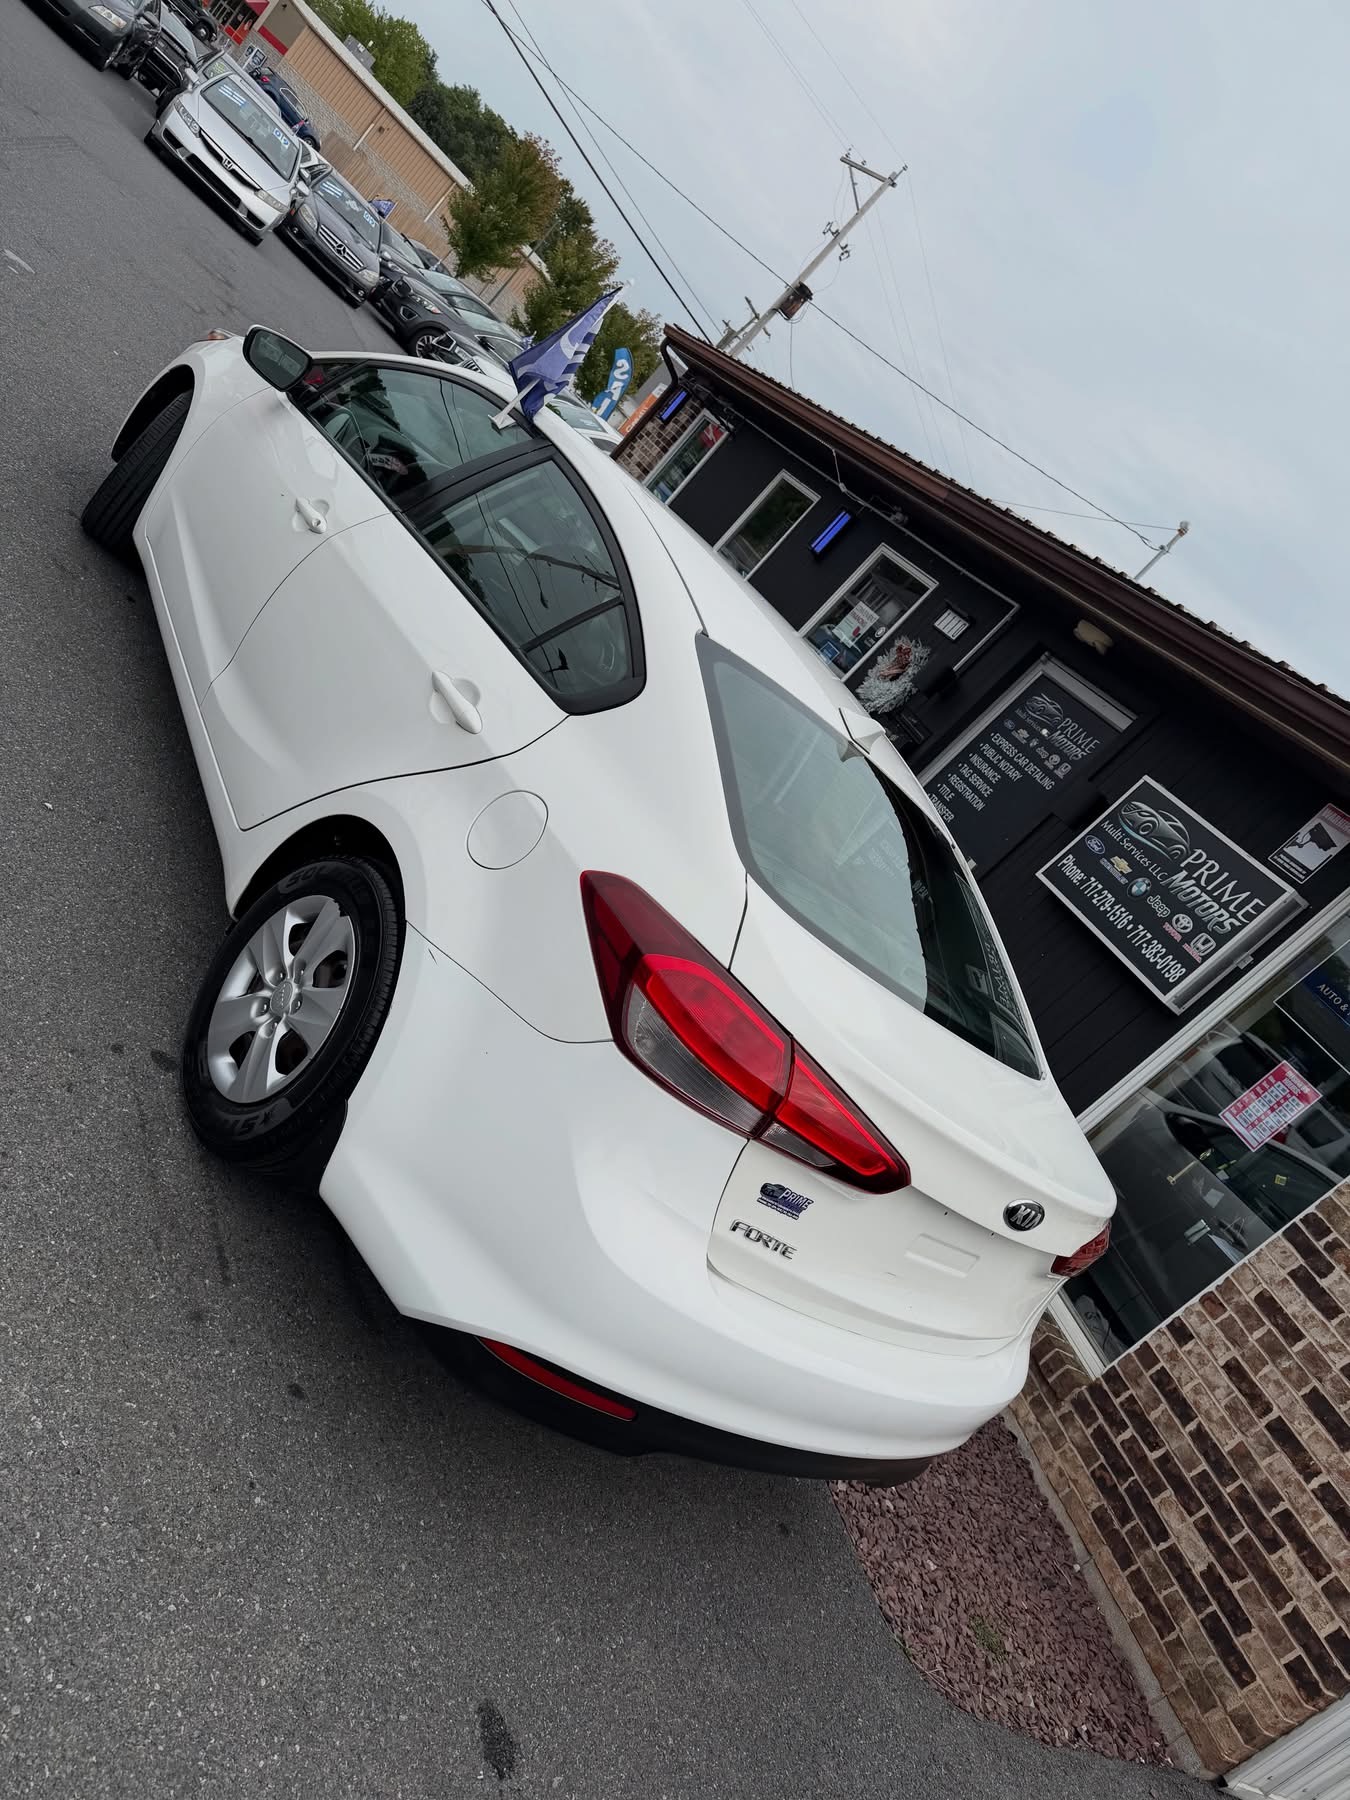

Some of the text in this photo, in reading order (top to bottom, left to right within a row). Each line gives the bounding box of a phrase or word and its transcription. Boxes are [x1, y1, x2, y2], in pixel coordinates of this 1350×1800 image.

[1047, 727, 1086, 759] MOTORS
[1057, 718, 1100, 754] PRIME
[970, 754, 1000, 783] INSURANCE
[981, 744, 1002, 763] PUBLIC
[998, 760, 1022, 781] NOTARY
[992, 734, 1017, 756] EXPRESS
[1014, 753, 1029, 767] CAR
[1025, 763, 1054, 789] DETALING
[939, 784, 954, 801] TITLE
[949, 774, 985, 810] REGISTRATION
[960, 764, 992, 797] TAG SERVICE
[1101, 820, 1167, 880] Multi Services LLC
[1164, 870, 1242, 934] MOTORS
[1180, 849, 1266, 924] PRIME
[1058, 854, 1186, 982] Phone: 717-279-1516 717-383-0198
[1147, 895, 1170, 917] Jeep
[1318, 984, 1342, 1004] AUTO
[780, 1188, 814, 1210] PRIME
[1010, 1205, 1042, 1230] KIA
[730, 1219, 798, 1260] FORTE
